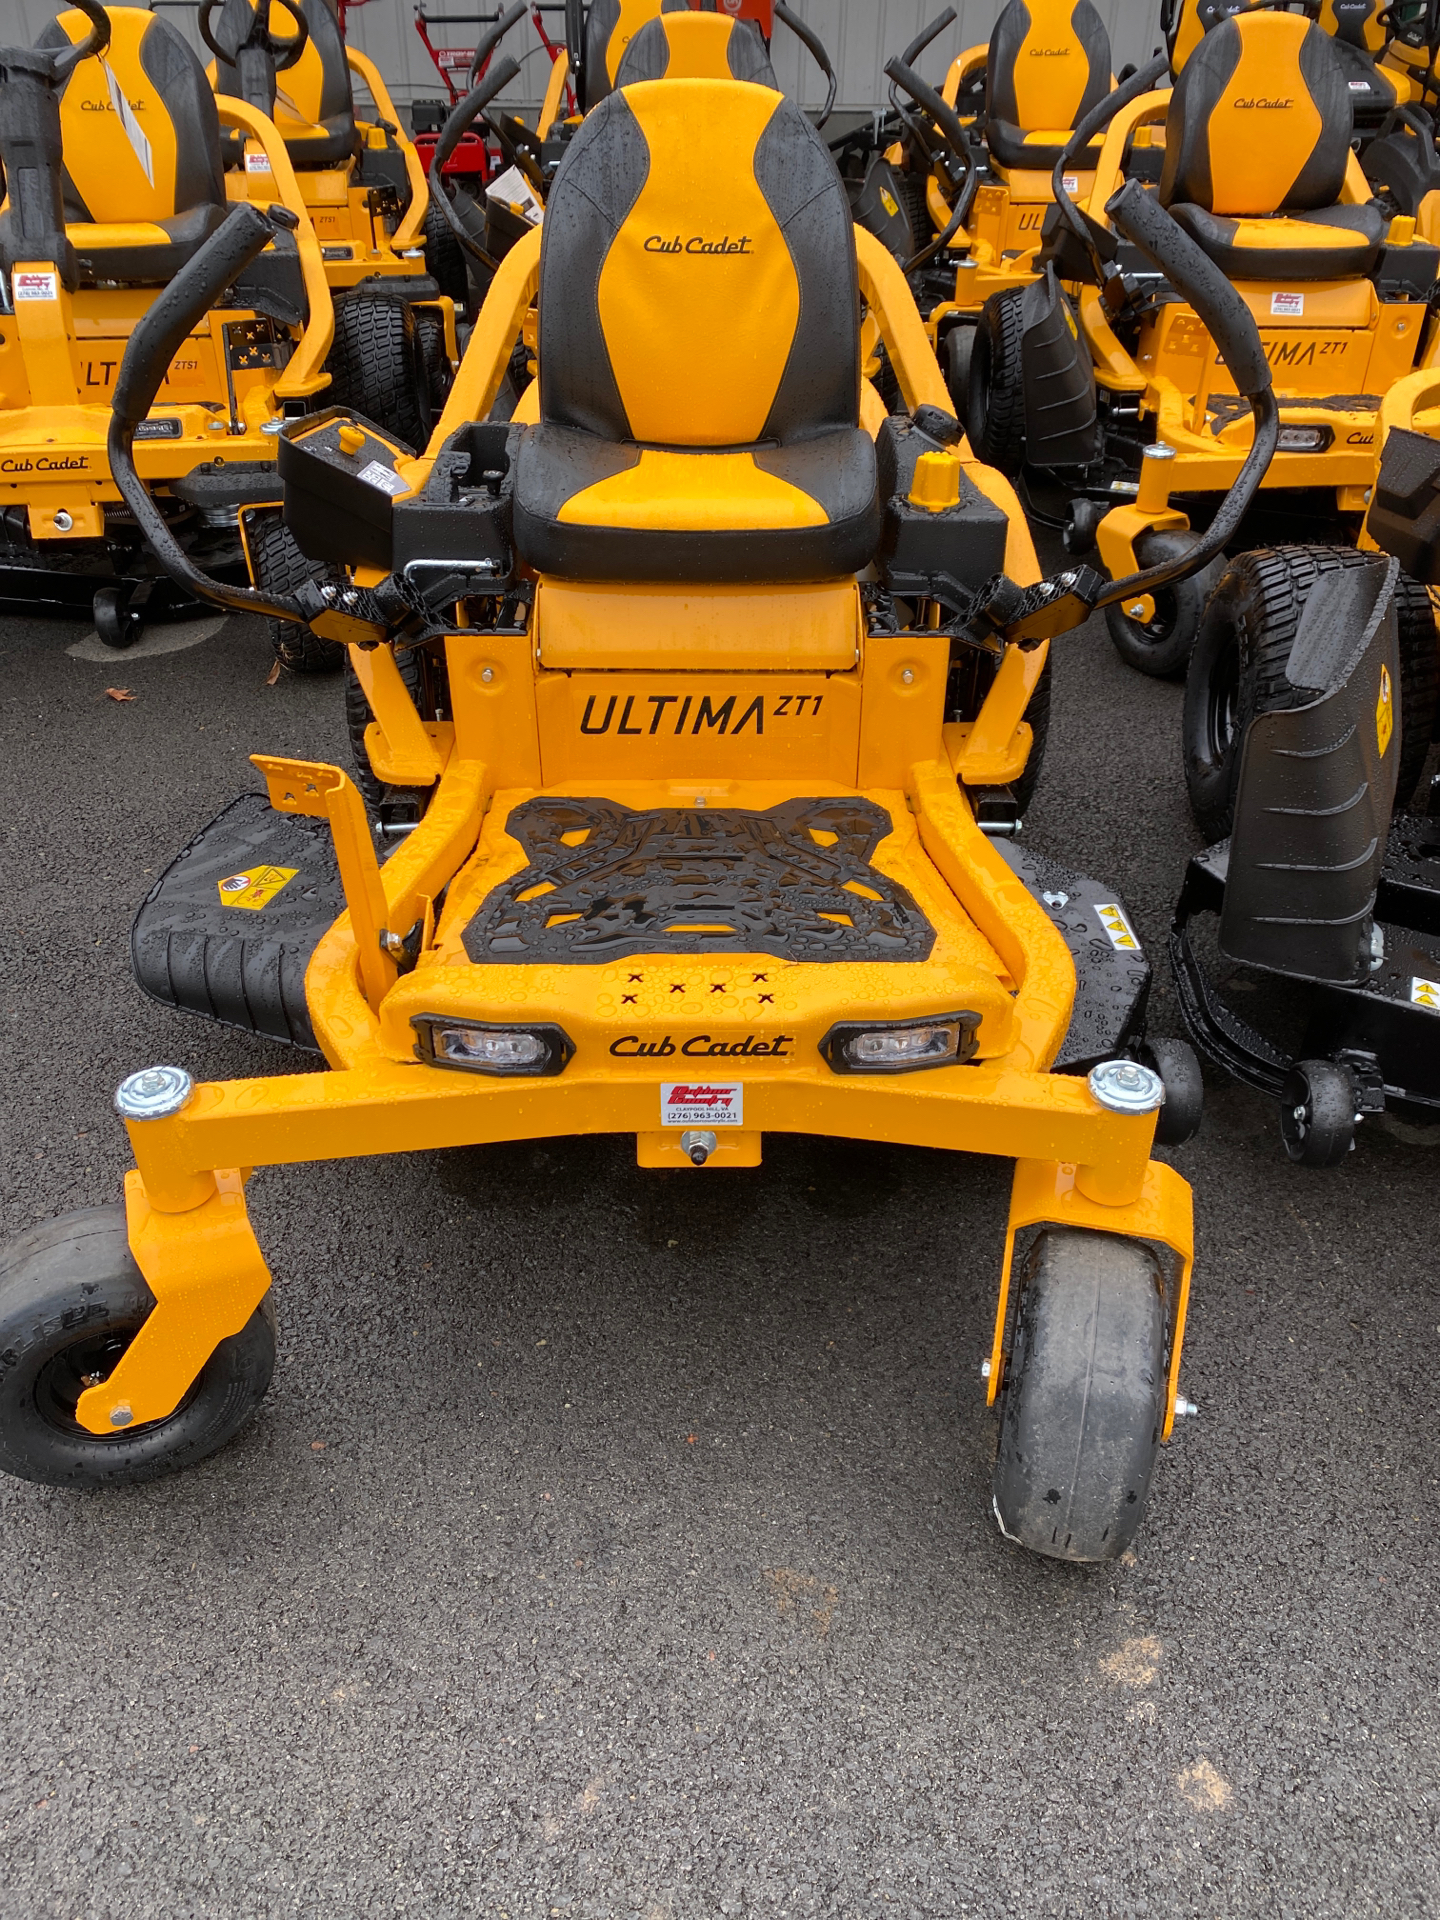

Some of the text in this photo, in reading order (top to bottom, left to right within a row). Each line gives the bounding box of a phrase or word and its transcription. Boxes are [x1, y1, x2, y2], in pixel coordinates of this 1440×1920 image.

[1029, 47, 1071, 57] Cub Cadet
[80, 99, 146, 111] Cub Cet
[1234, 98, 1294, 109] Cub Cadet
[643, 235, 753, 254] Cub Cadet
[1319, 341, 1349, 354] ZT1
[174, 360, 198, 370] ZTS1
[1, 455, 90, 472] Cub Cadet
[580, 695, 824, 735] ULTIMA ZT1
[609, 1034, 794, 1057] Cub Cadet
